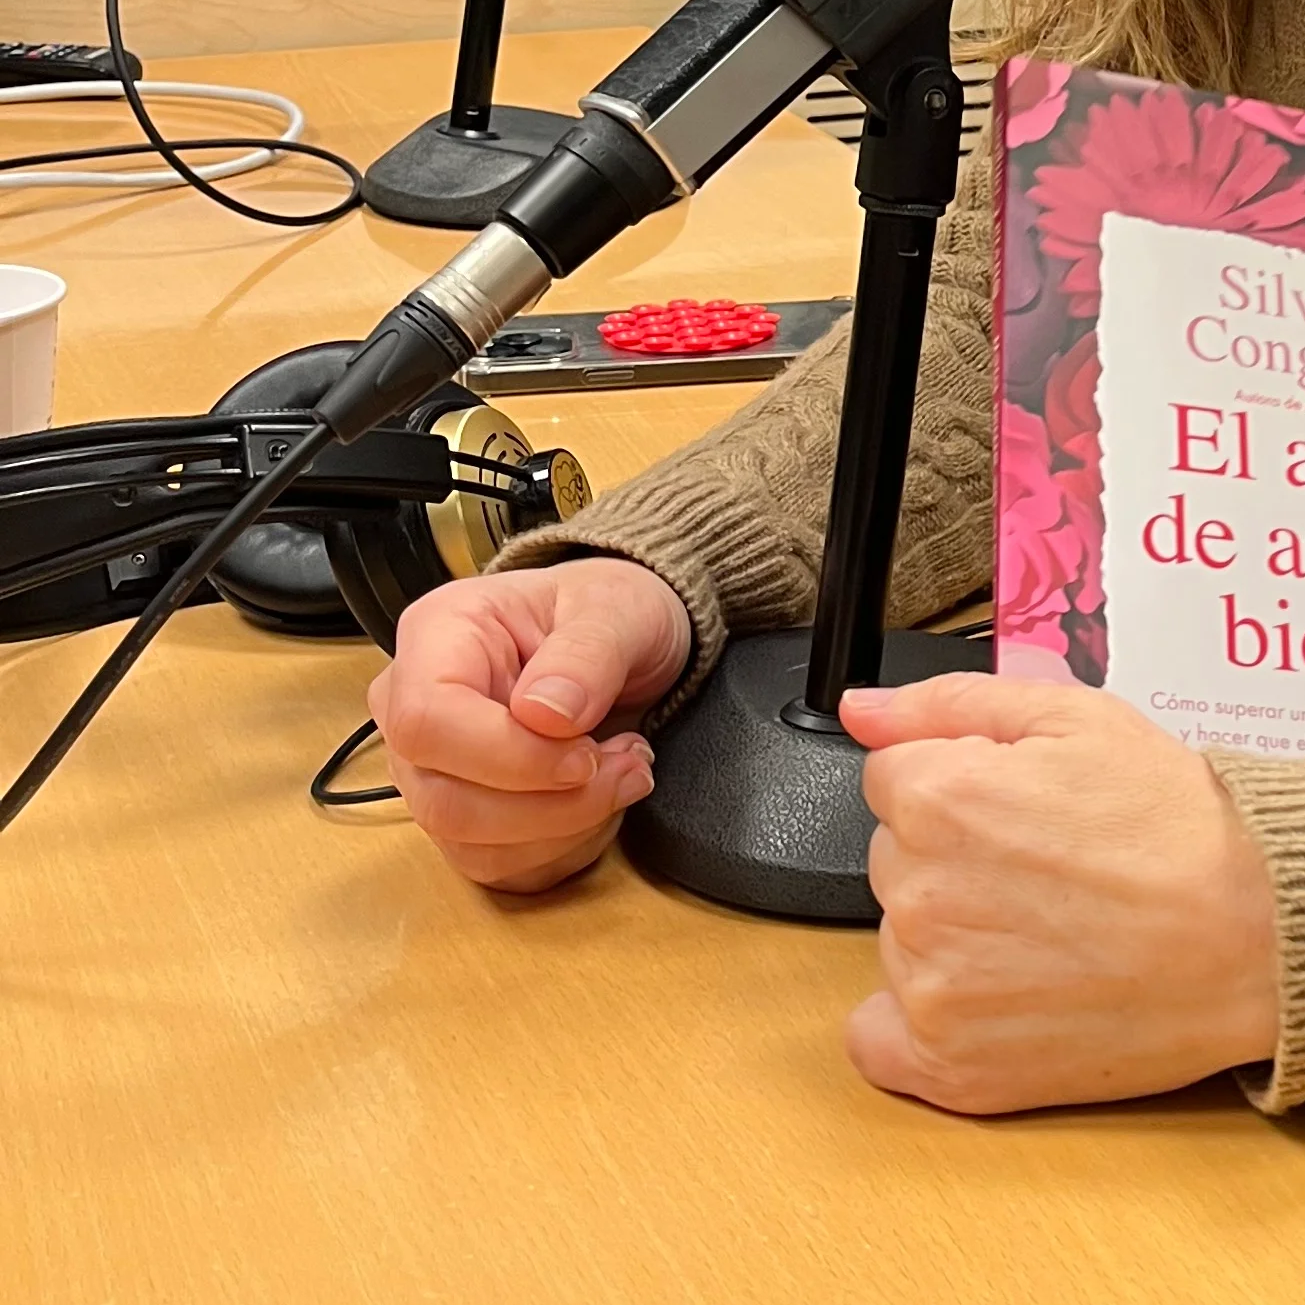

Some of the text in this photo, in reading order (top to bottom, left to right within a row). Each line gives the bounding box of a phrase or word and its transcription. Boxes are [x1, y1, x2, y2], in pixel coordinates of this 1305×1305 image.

[1283, 396, 1302, 411] de
[1168, 401, 1257, 480] El
[1142, 494, 1238, 569] de
[1150, 691, 1209, 712] Cómo
[1215, 702, 1286, 721] superar
[1179, 728, 1192, 744] y
[1196, 722, 1251, 745] hacer
[1256, 734, 1290, 753] que
